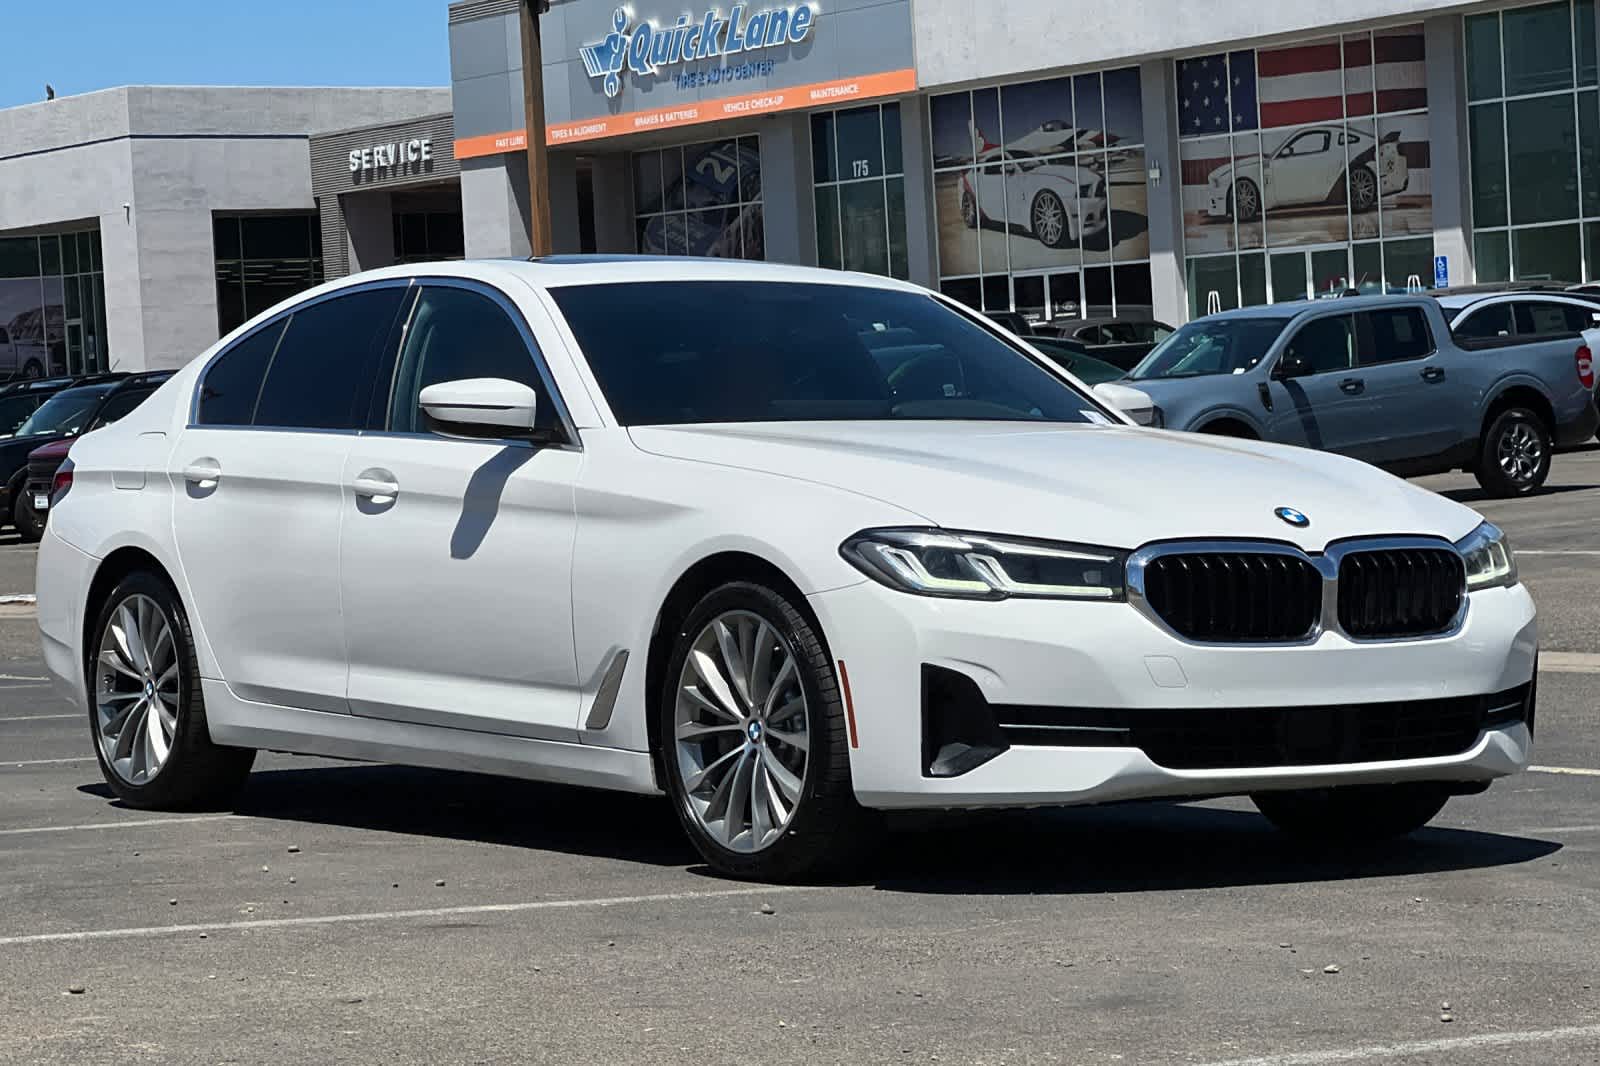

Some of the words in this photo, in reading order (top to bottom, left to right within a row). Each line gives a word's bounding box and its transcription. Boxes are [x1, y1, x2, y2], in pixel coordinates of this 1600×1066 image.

[627, 10, 727, 75] Quick
[725, 5, 812, 54] Lane
[673, 72, 697, 90] TIRE
[707, 66, 734, 84] AUTO
[736, 60, 775, 81] CENTER
[810, 84, 859, 99] MAINTENANCE
[723, 101, 750, 113] VEHICLE
[751, 95, 784, 109] CHECK-UP
[634, 113, 659, 127] BRAKES
[665, 108, 698, 122] BATTERIES
[551, 128, 568, 140] TIRES
[574, 122, 607, 137] ALIGNMENT
[495, 137, 508, 148] FAST
[349, 139, 432, 172] SERVICE
[852, 159, 869, 177] 175
